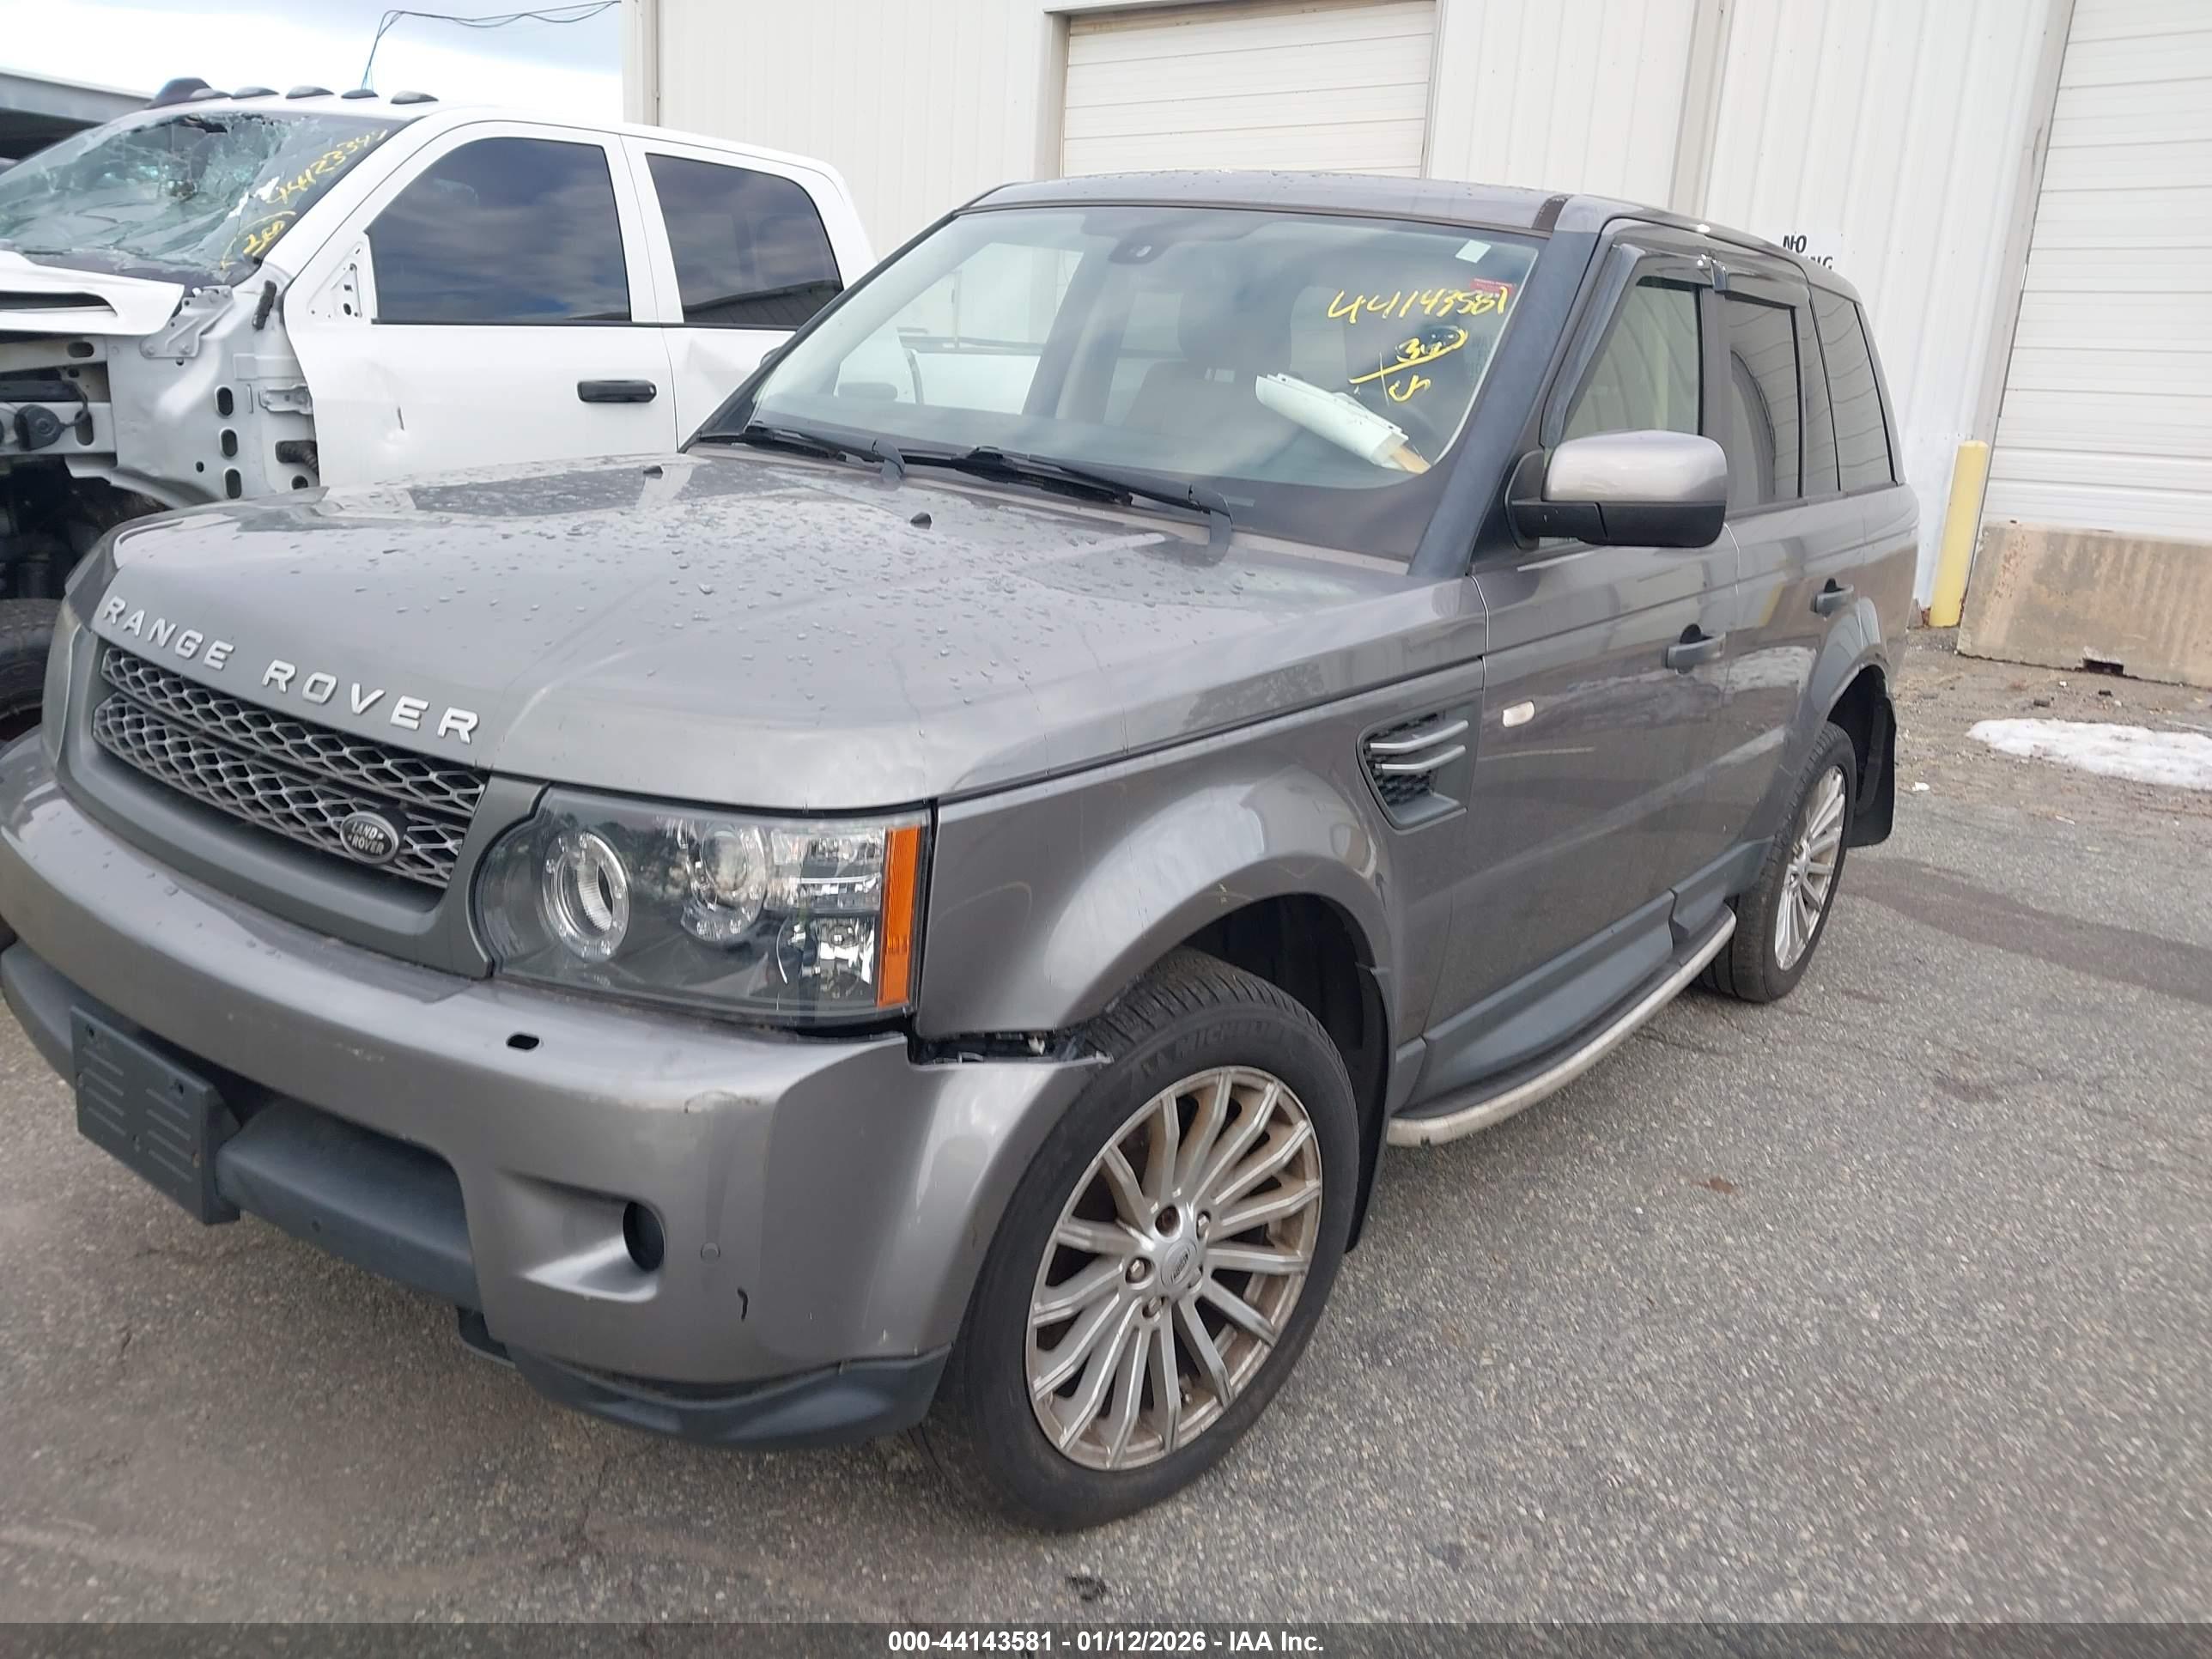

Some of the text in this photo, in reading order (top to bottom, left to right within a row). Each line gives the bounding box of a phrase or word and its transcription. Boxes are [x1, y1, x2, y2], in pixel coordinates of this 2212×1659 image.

[1782, 234, 1808, 255] NO
[102, 595, 481, 745] RANGE ROVER
[351, 821, 379, 840] LAND
[351, 834, 385, 855] ROVER
